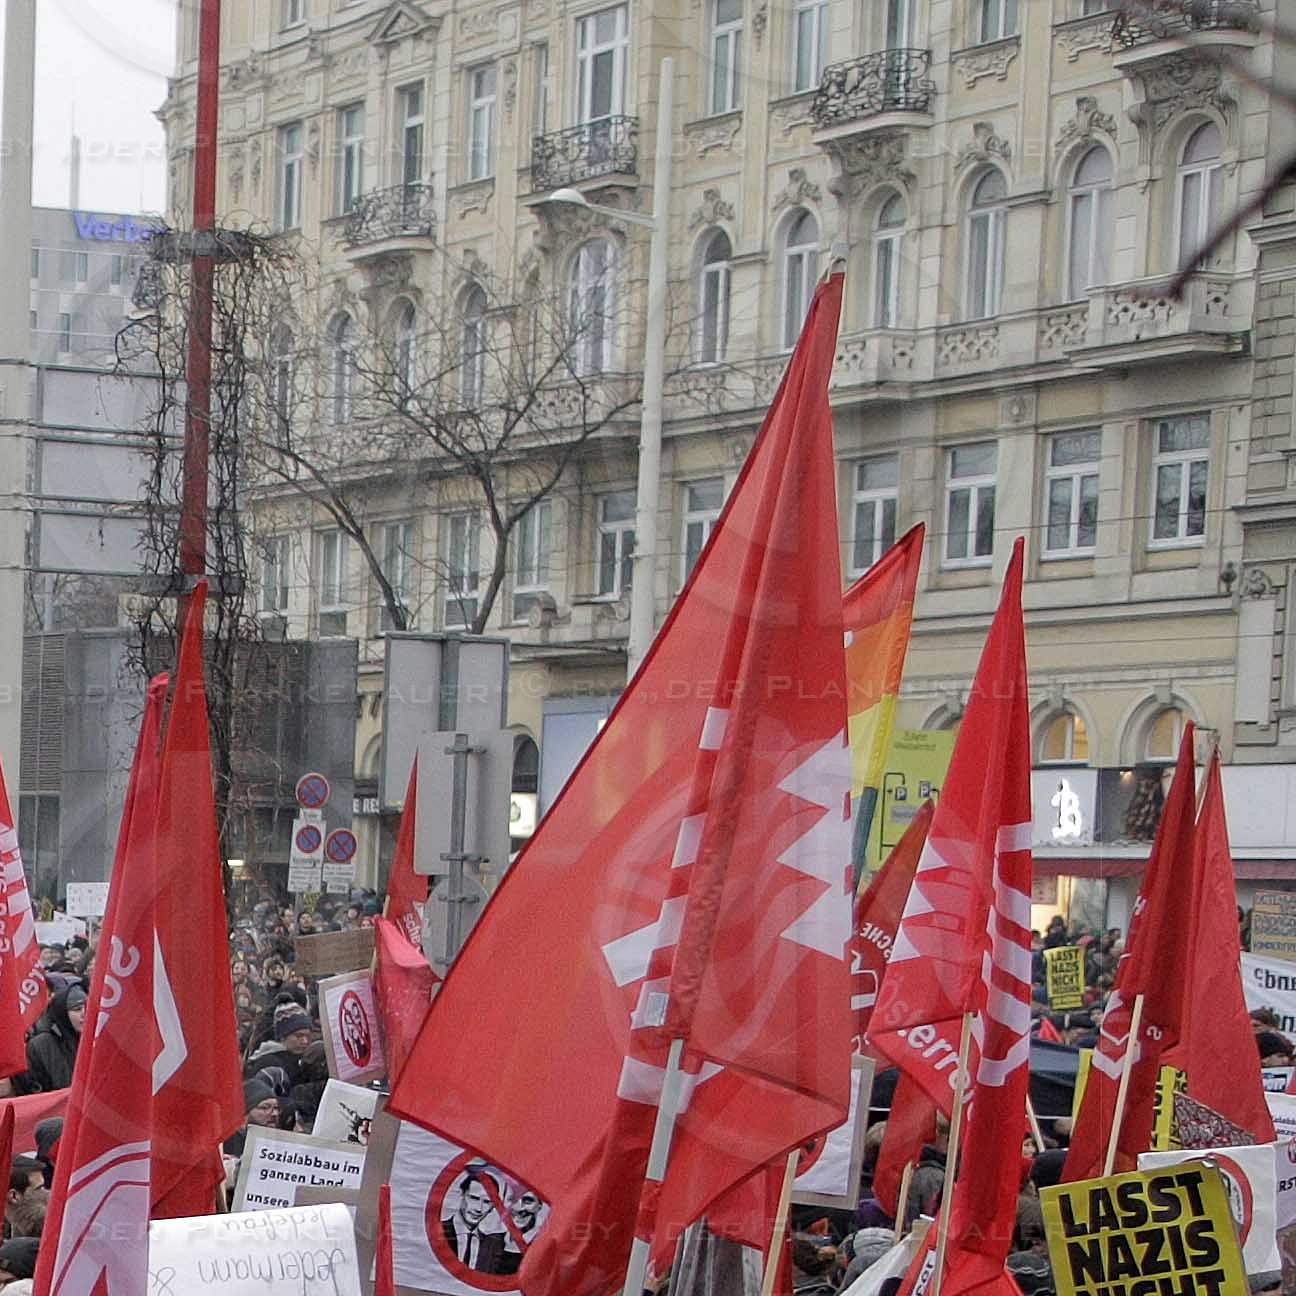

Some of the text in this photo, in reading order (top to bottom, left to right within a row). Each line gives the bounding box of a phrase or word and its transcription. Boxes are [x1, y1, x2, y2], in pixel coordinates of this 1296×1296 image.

[258, 1147, 361, 1176] Sozialabbau im
[259, 1167, 307, 1184] ganzen
[246, 1192, 290, 1208] unsere
[1058, 1171, 1204, 1238] LASST
[1066, 1219, 1220, 1287] NAZIS
